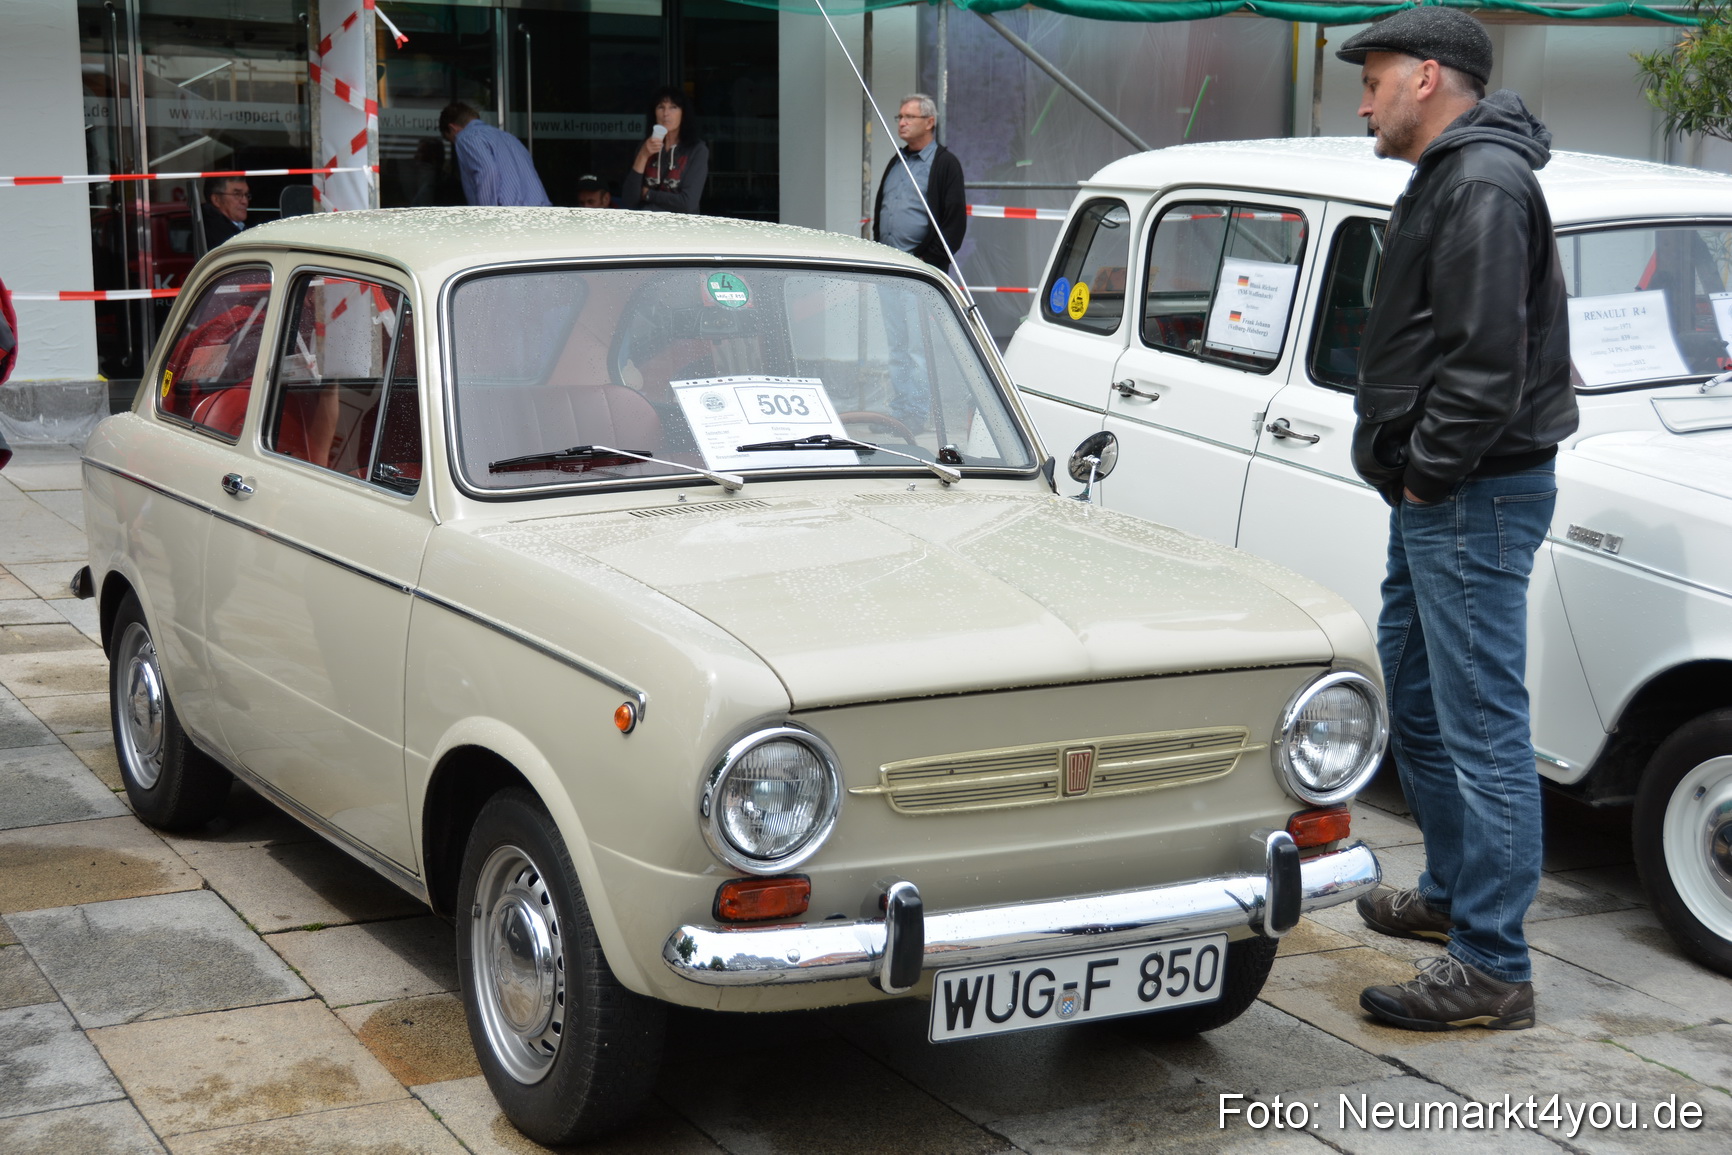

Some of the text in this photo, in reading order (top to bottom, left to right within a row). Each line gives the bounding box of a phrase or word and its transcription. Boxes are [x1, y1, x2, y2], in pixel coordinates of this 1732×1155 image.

[169, 106, 301, 125] www.kl-ruppert.de
[721, 274, 733, 291] 4
[1584, 308, 1627, 321] RENAULT
[756, 394, 810, 416] 503
[1070, 753, 1089, 791] FIAT
[943, 957, 1120, 1031] WUG-F
[1137, 944, 1220, 1003] 850
